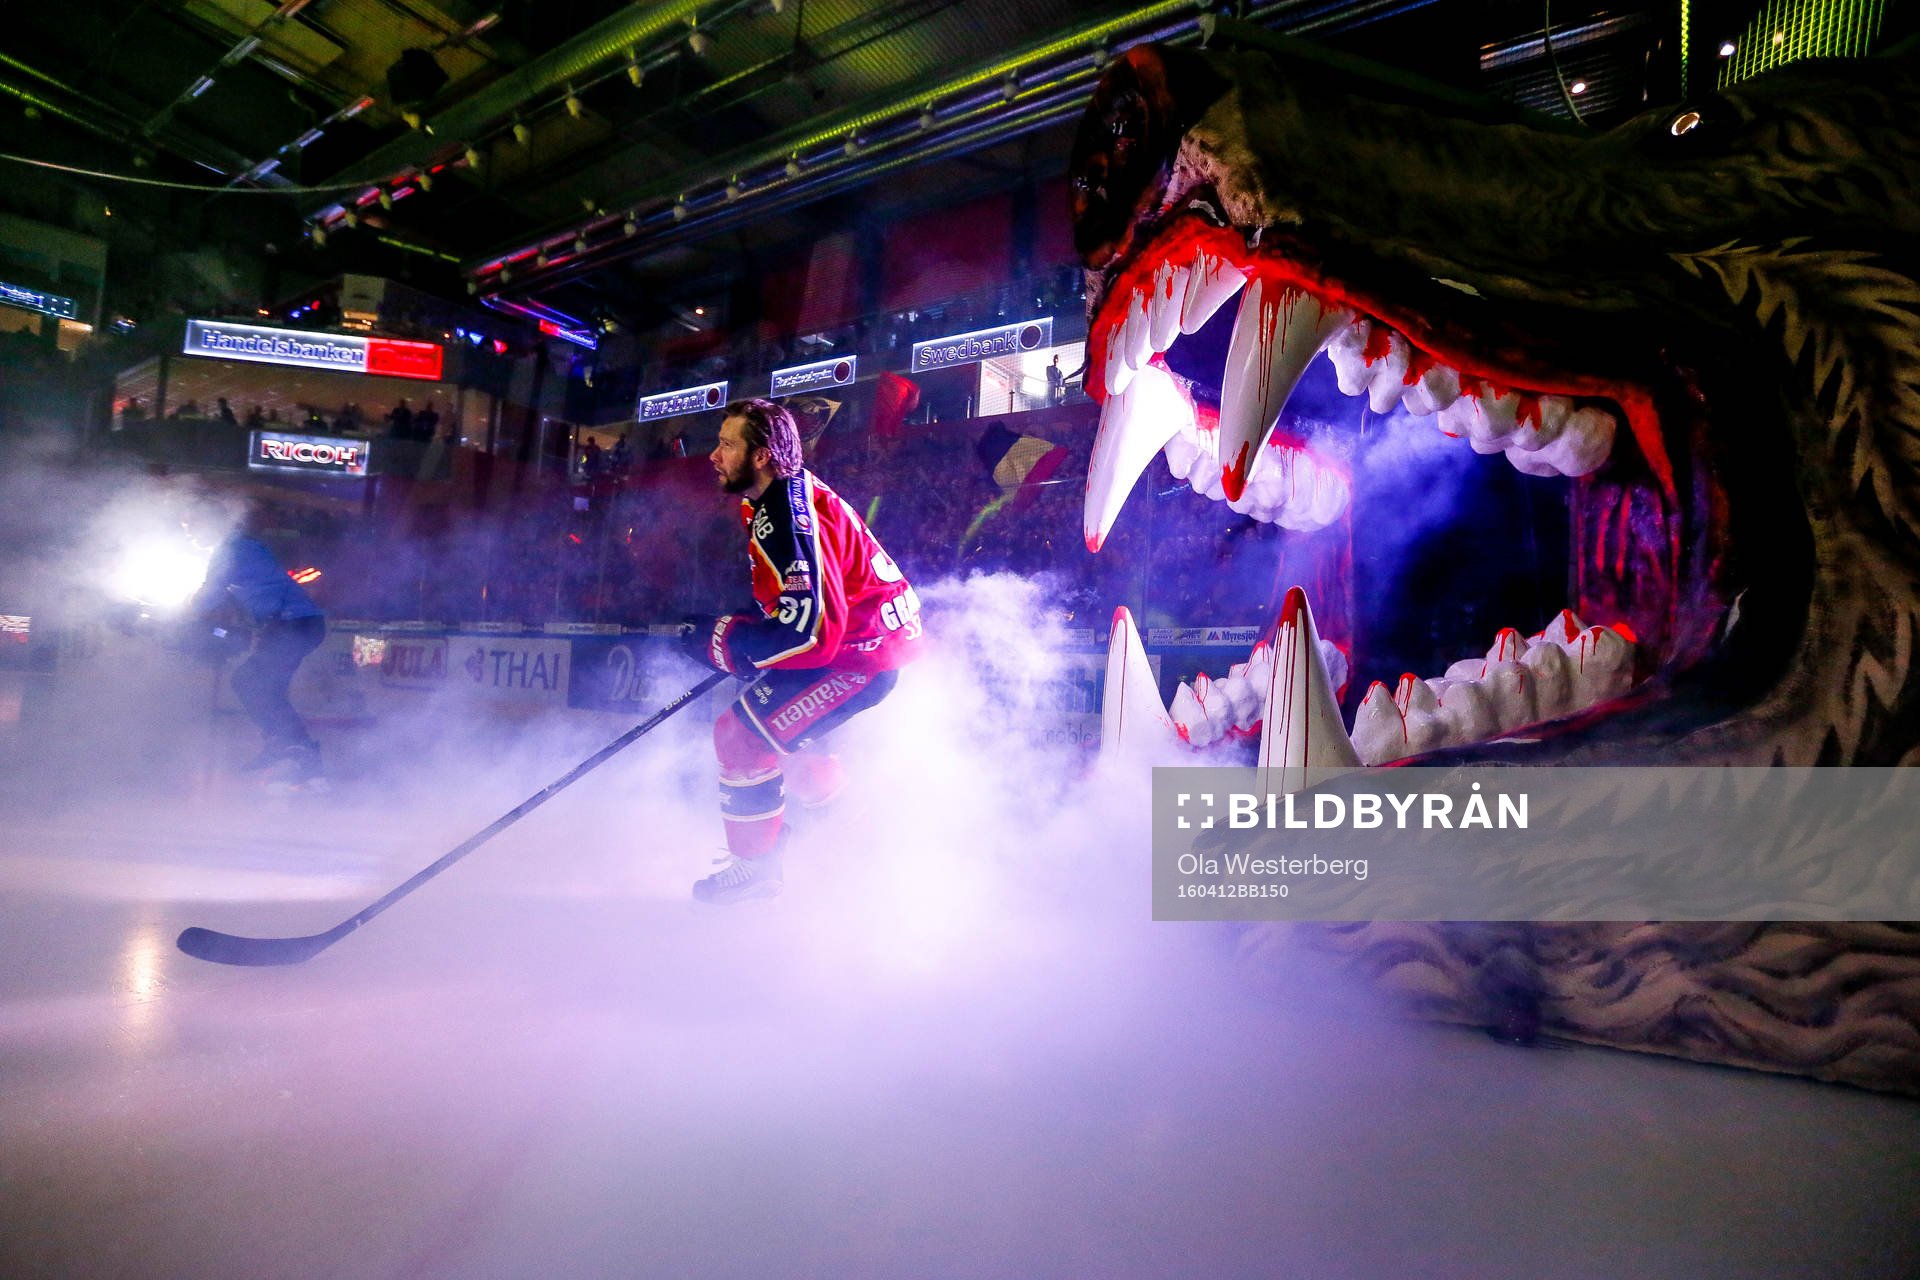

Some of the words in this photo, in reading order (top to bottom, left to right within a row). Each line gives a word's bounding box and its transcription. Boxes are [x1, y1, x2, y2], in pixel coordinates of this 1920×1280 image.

[200, 329, 364, 364] Handelsbanken
[919, 331, 1017, 365] Swedbank
[260, 439, 358, 466] RICOH
[779, 596, 812, 633] 31
[382, 645, 444, 678] JULA
[490, 650, 560, 690] THAI
